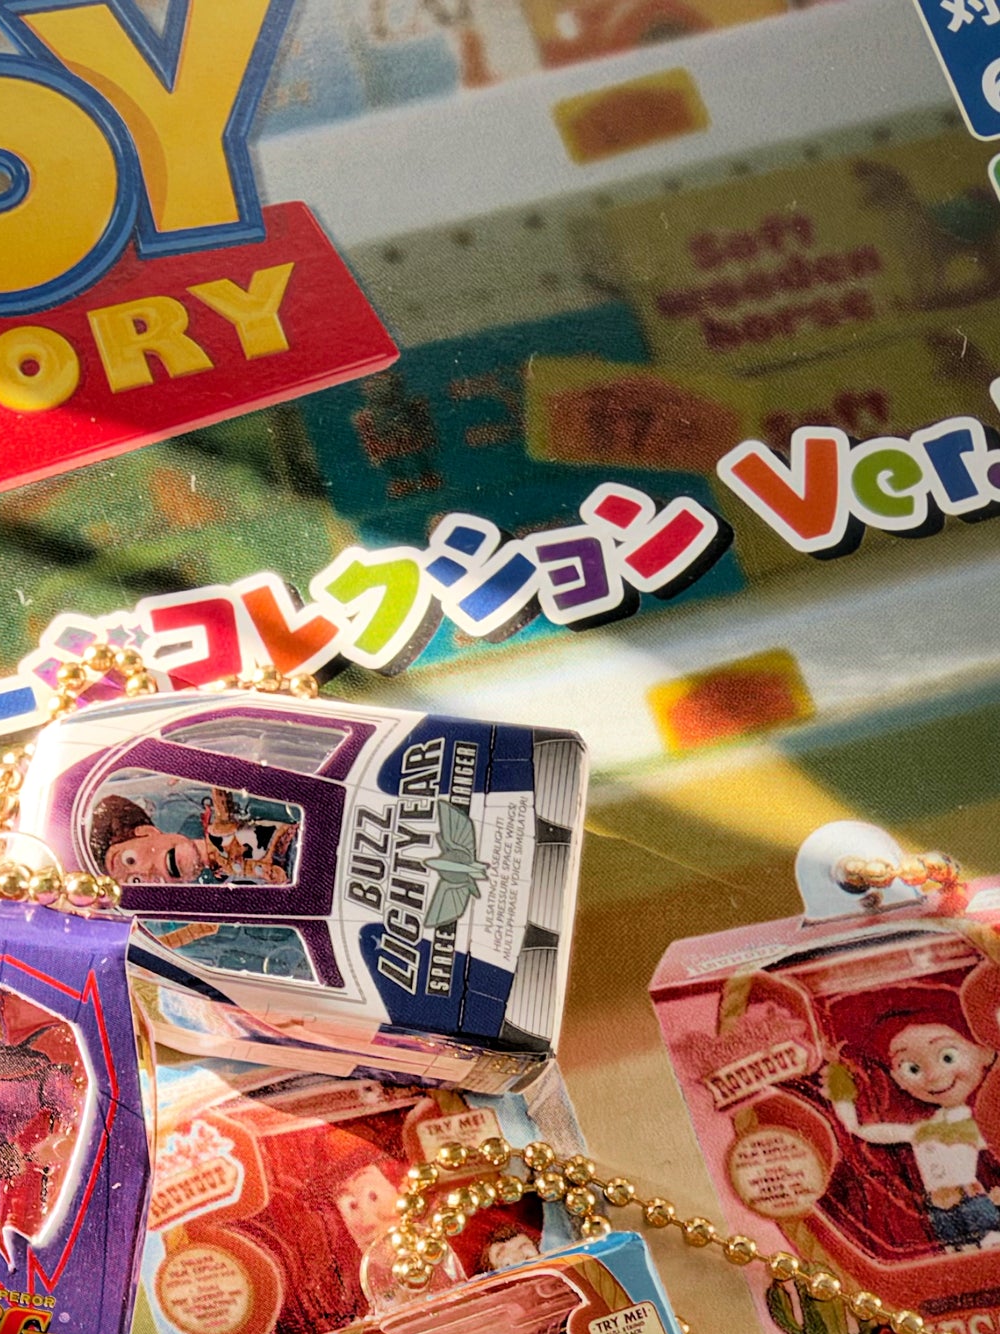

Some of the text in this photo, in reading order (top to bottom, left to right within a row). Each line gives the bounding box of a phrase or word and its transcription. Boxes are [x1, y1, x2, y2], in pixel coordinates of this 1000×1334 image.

[514, 795, 528, 855] SIMULATOR!
[346, 804, 396, 912] BUZZ
[377, 737, 446, 996] LIGHTYEAR
[494, 803, 518, 953] HIGH PRESSURE SPACE WINGS!
[511, 857, 522, 887] VOICE
[484, 879, 498, 935] PULSATING
[429, 929, 456, 992] SPACE
[711, 1047, 799, 1100] ROUNDUP
[595, 1307, 648, 1333] TRY ME!
